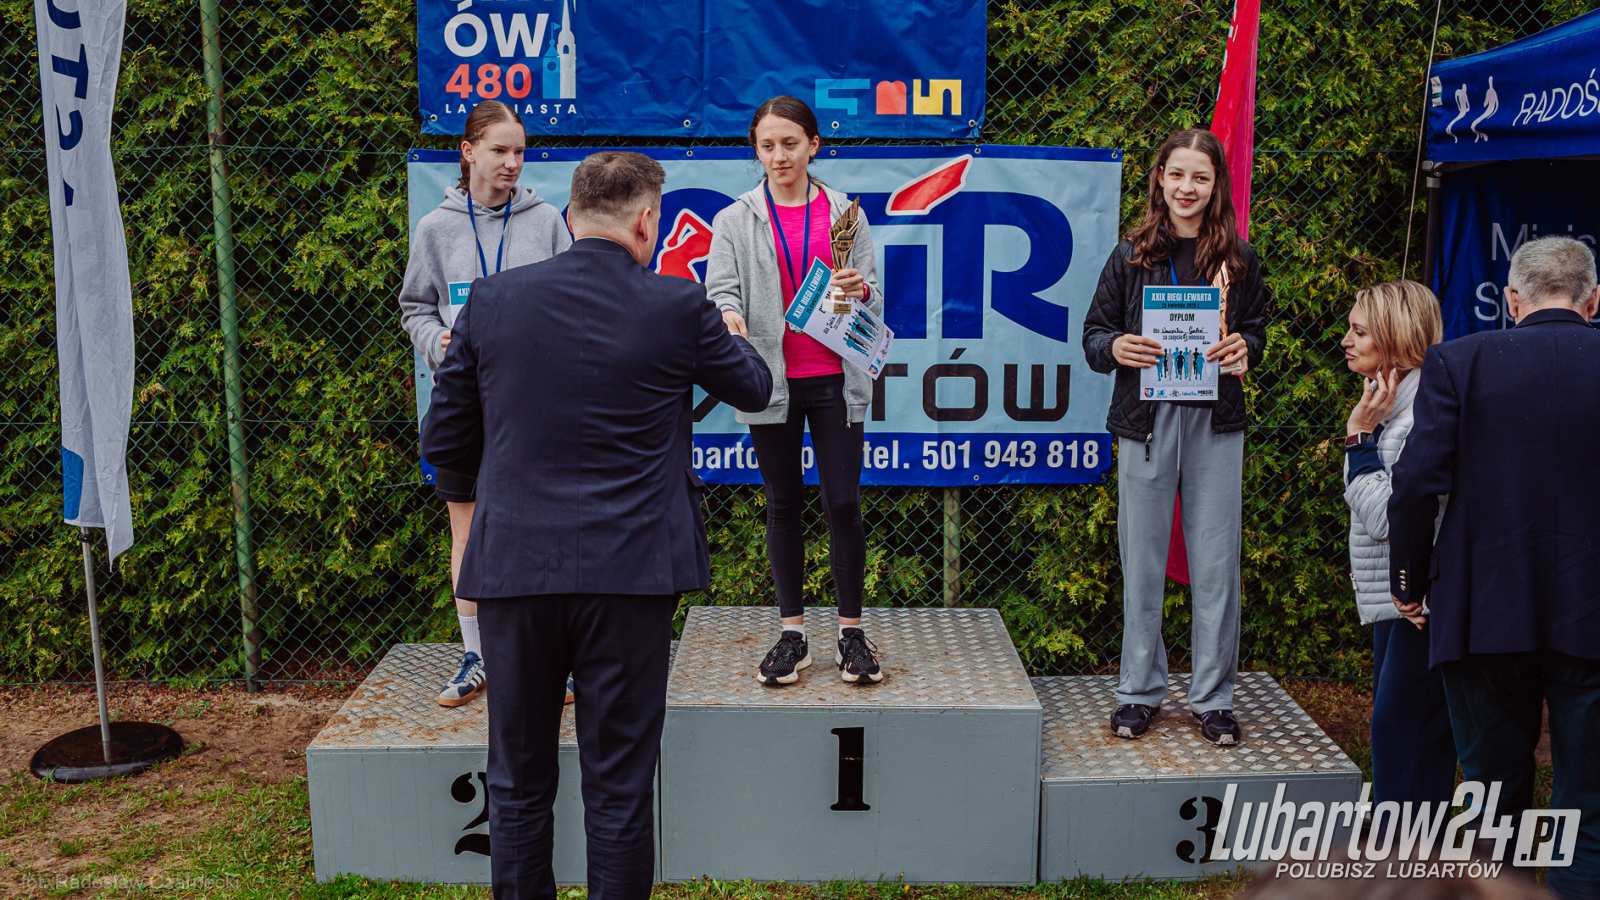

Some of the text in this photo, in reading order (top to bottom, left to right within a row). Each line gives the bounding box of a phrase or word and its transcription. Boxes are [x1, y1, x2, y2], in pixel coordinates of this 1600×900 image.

[445, 63, 532, 99] 480
[1512, 68, 1600, 126] RADOŚ
[513, 104, 577, 114] IASTA
[1151, 292, 1212, 302] XXIX BIEGI LEWARTA
[1169, 313, 1195, 321] DYPLOM
[863, 440, 910, 469] tel.
[922, 440, 972, 470] 501
[984, 440, 1038, 469] 943
[1046, 440, 1100, 469] 818
[830, 726, 871, 811] 1
[450, 771, 492, 857] 2
[1175, 796, 1227, 863] 3
